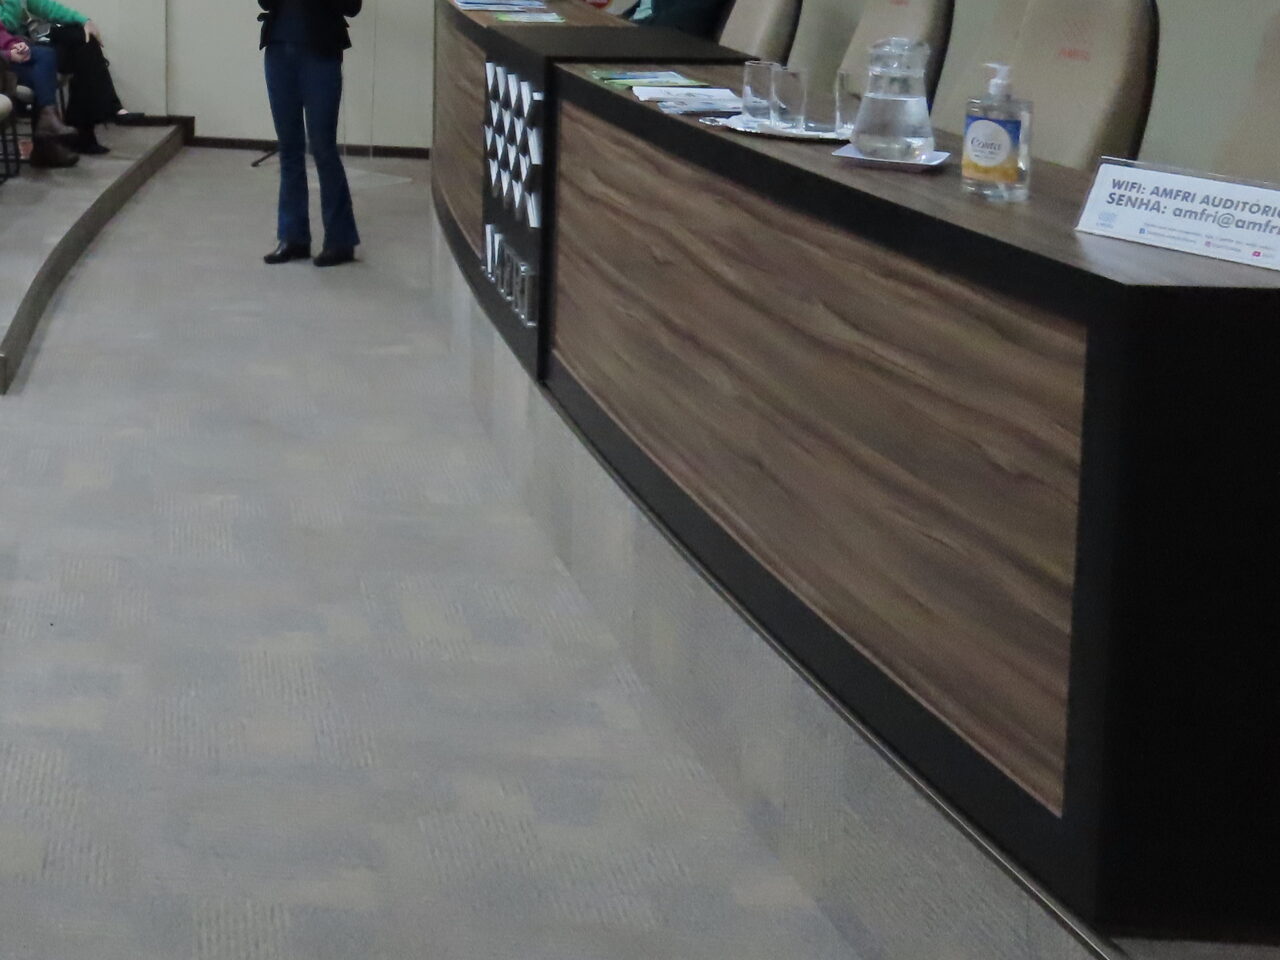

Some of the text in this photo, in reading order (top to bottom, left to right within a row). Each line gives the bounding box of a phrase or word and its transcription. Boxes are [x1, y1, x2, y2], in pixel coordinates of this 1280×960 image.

[1111, 178, 1146, 195] WIFI:
[1149, 186, 1197, 203] AMFRI
[1106, 192, 1167, 215] SENHA:
